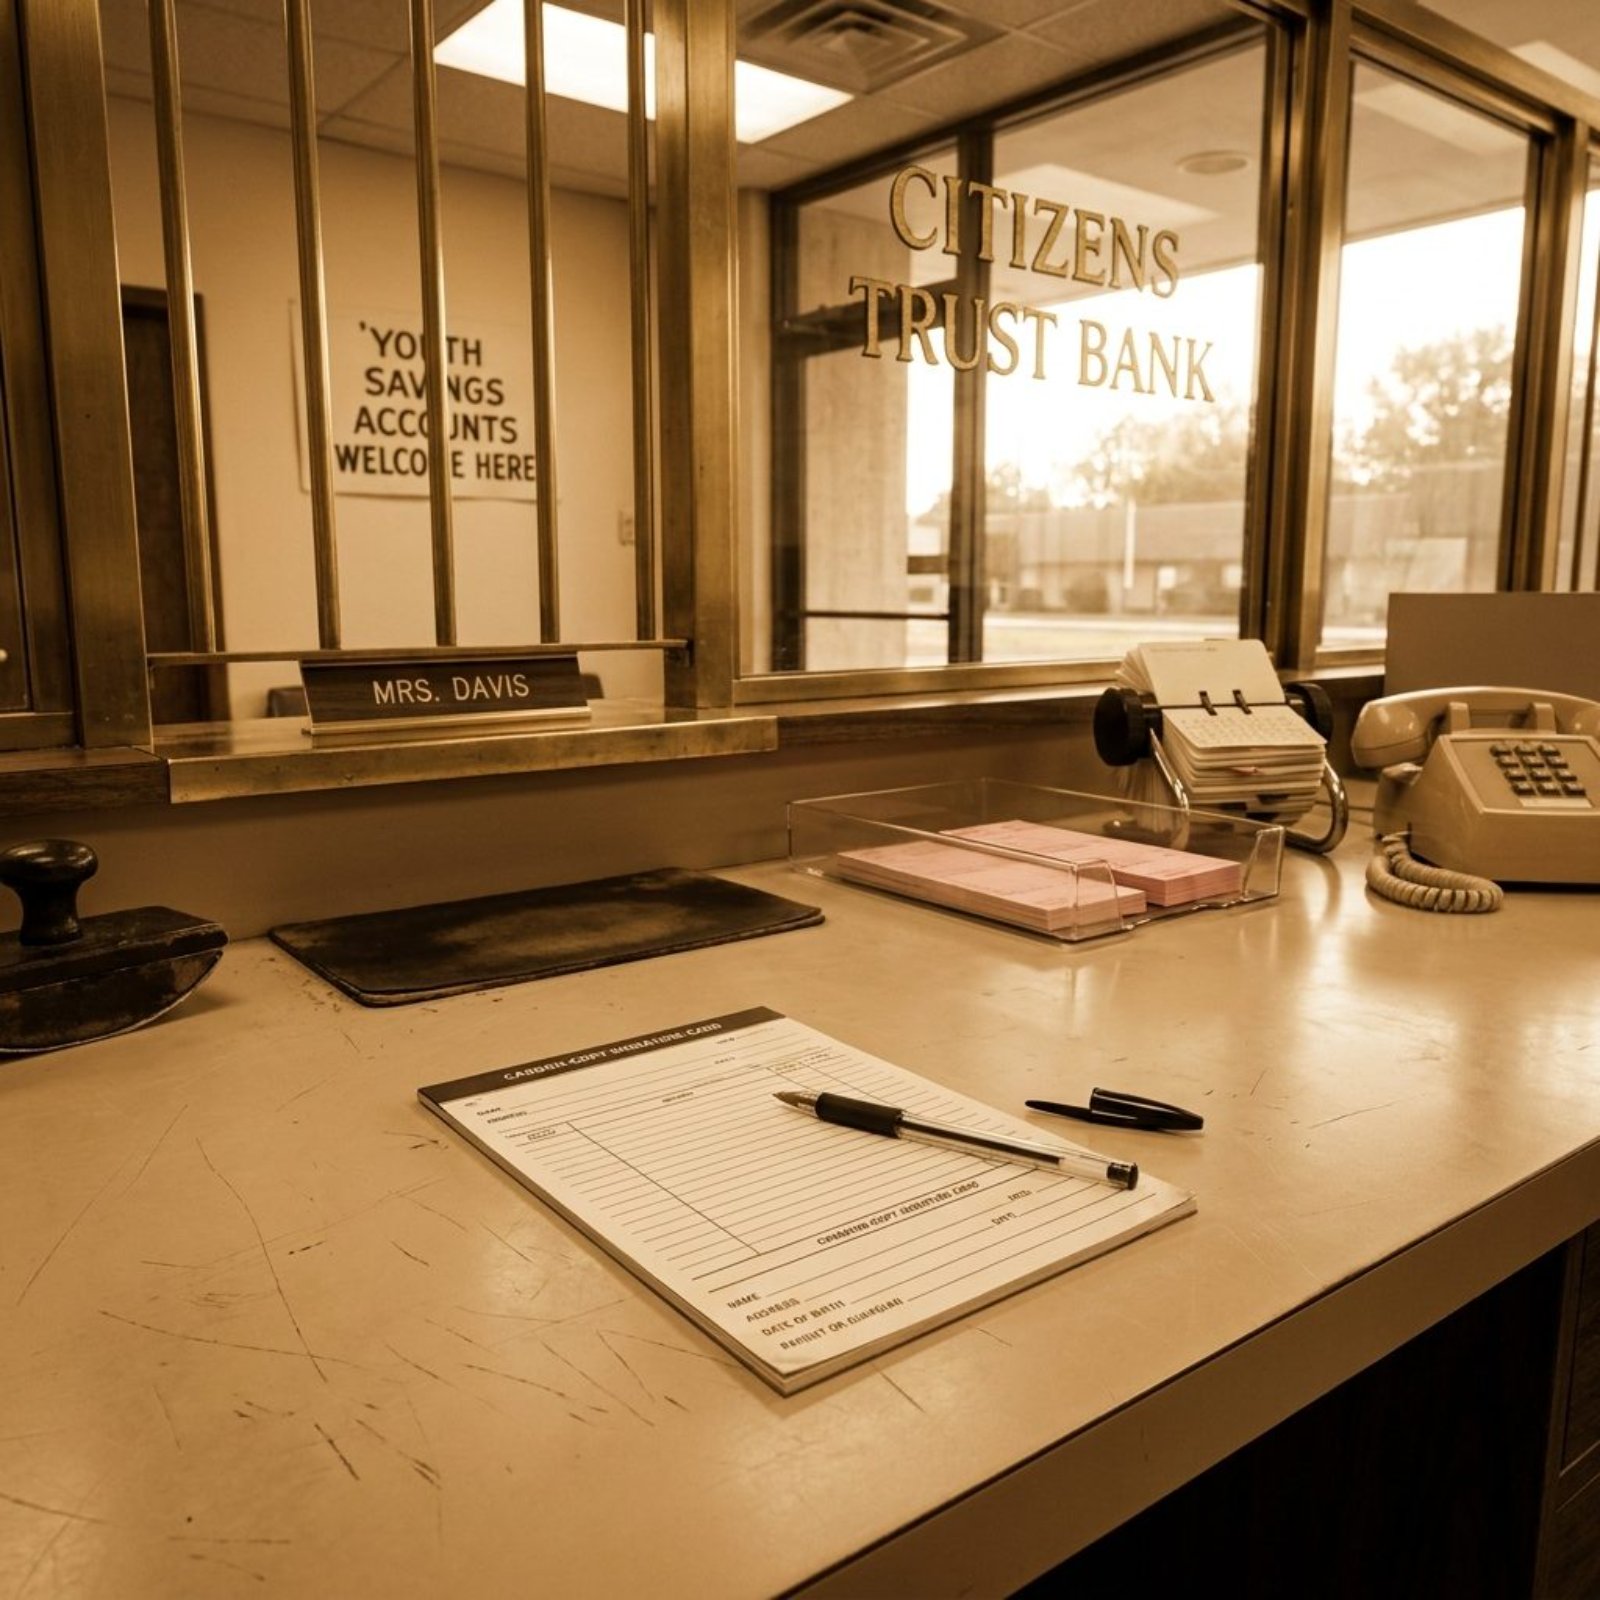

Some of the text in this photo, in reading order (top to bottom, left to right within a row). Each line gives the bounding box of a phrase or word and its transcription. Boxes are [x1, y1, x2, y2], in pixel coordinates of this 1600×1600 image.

[890, 165, 1179, 298] CITIZENS
[359, 321, 481, 367] 'YOTH
[849, 276, 1214, 402] TRUST BANK
[365, 366, 504, 406] SAVNGS
[334, 444, 535, 481] WELCOE HERE
[372, 674, 530, 704] MRS. DAVIS
